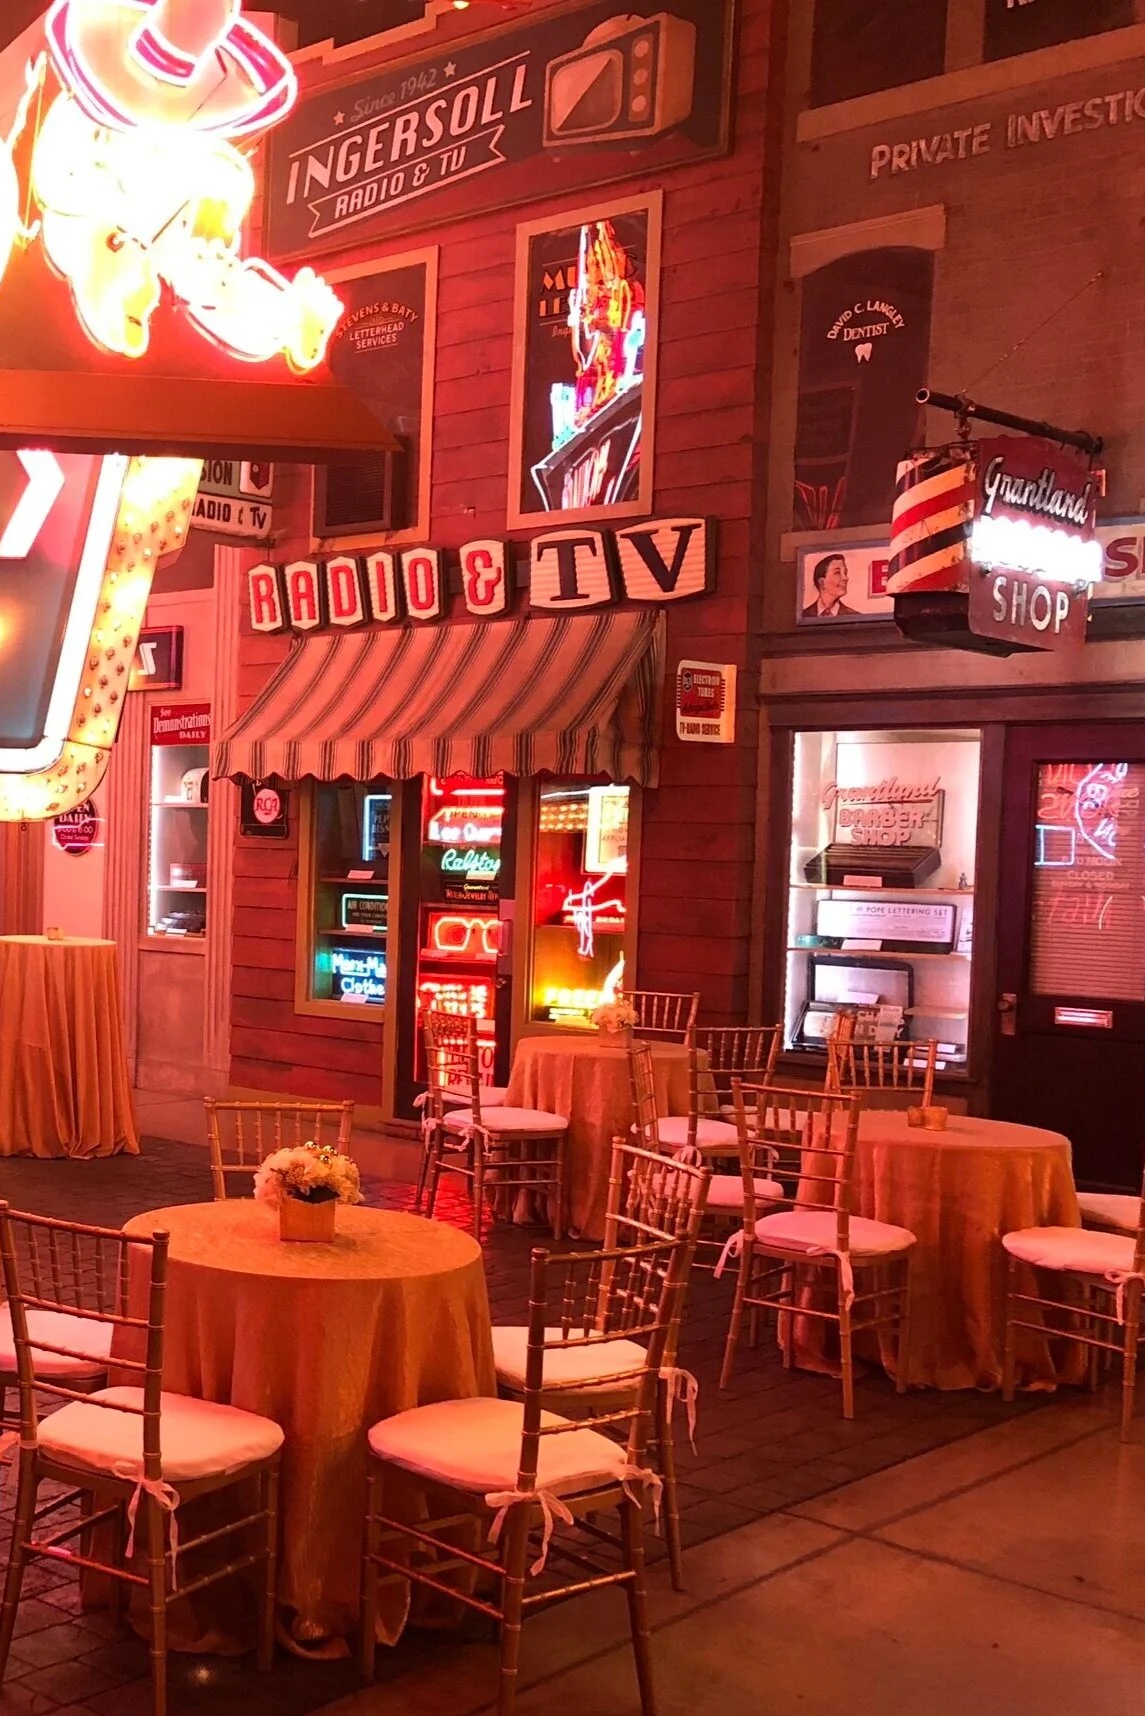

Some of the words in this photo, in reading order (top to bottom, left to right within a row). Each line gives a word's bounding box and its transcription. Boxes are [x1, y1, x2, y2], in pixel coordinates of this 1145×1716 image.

[350, 90, 396, 122] Since
[400, 67, 437, 99] 1942
[286, 63, 533, 205] INGERSOLL
[870, 122, 991, 179] PRIVATE
[334, 171, 403, 220] RADIO
[412, 161, 431, 187] &
[439, 145, 467, 179] TV
[336, 302, 380, 339] STEVENS
[381, 302, 390, 312] &
[391, 302, 418, 323] BATY
[349, 321, 405, 341] LETTERHEAD
[826, 310, 853, 340] DAVID
[866, 300, 905, 329] LANGLEY
[843, 322, 890, 341] DENTIST
[357, 333, 397, 350] SERVICES
[984, 456, 1091, 525] Grantland
[255, 556, 432, 625] RADIO
[465, 551, 502, 606] &
[536, 523, 702, 602] TV
[992, 575, 1070, 634] SHOP
[153, 712, 211, 734] Demonstrations
[179, 730, 207, 740] DAILY
[256, 797, 278, 812] RCA
[839, 808, 925, 829] BARBER
[851, 828, 911, 846] SHOP
[866, 906, 885, 914] POPE
[888, 907, 931, 916] LETTERING
[934, 909, 948, 917] SET
